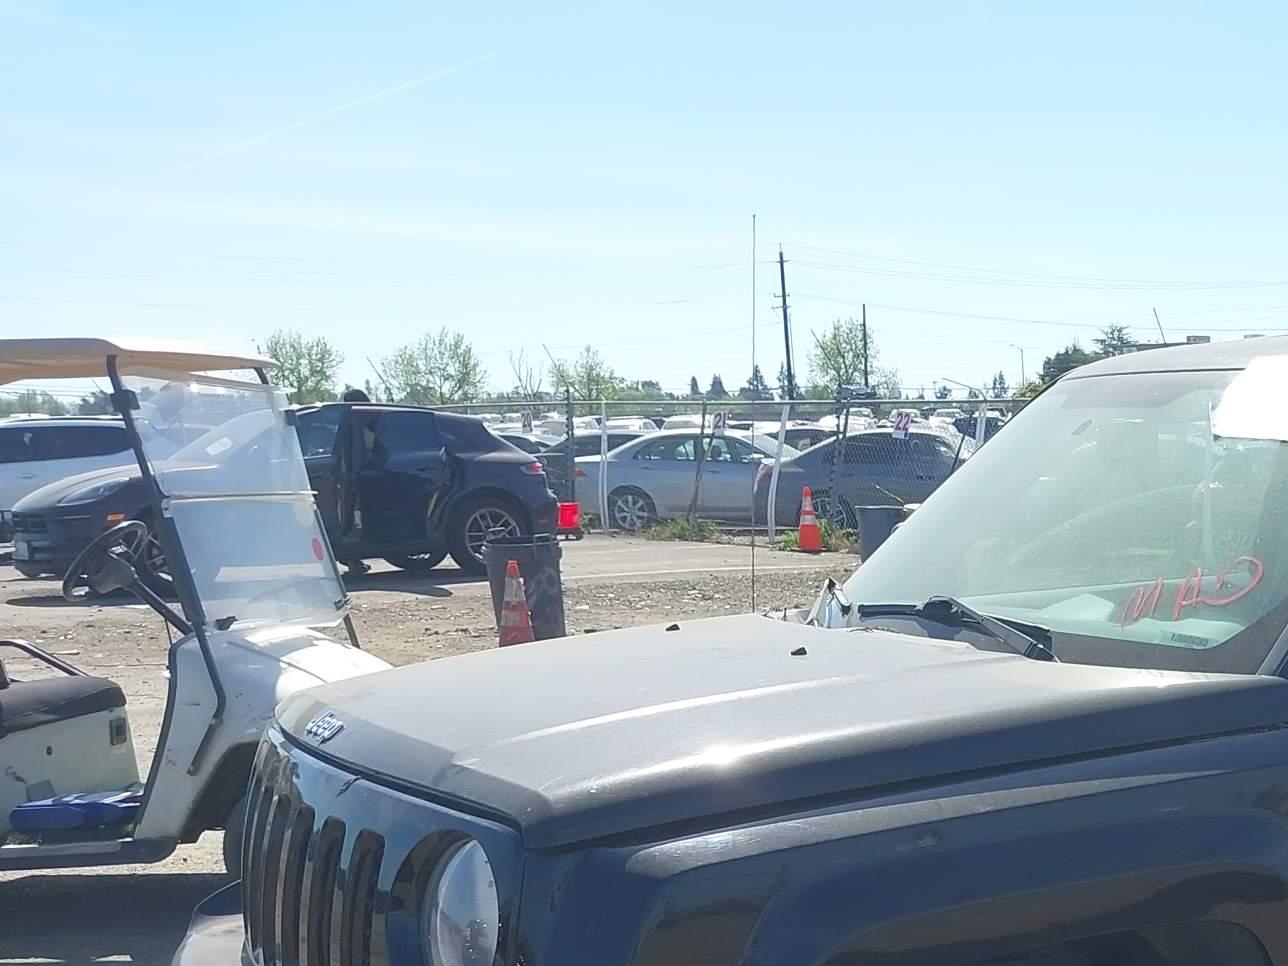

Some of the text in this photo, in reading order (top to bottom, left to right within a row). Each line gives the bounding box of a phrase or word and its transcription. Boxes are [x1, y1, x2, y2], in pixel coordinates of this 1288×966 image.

[713, 412, 726, 429] 21
[894, 412, 911, 432] 22
[305, 711, 346, 745] Jeep
